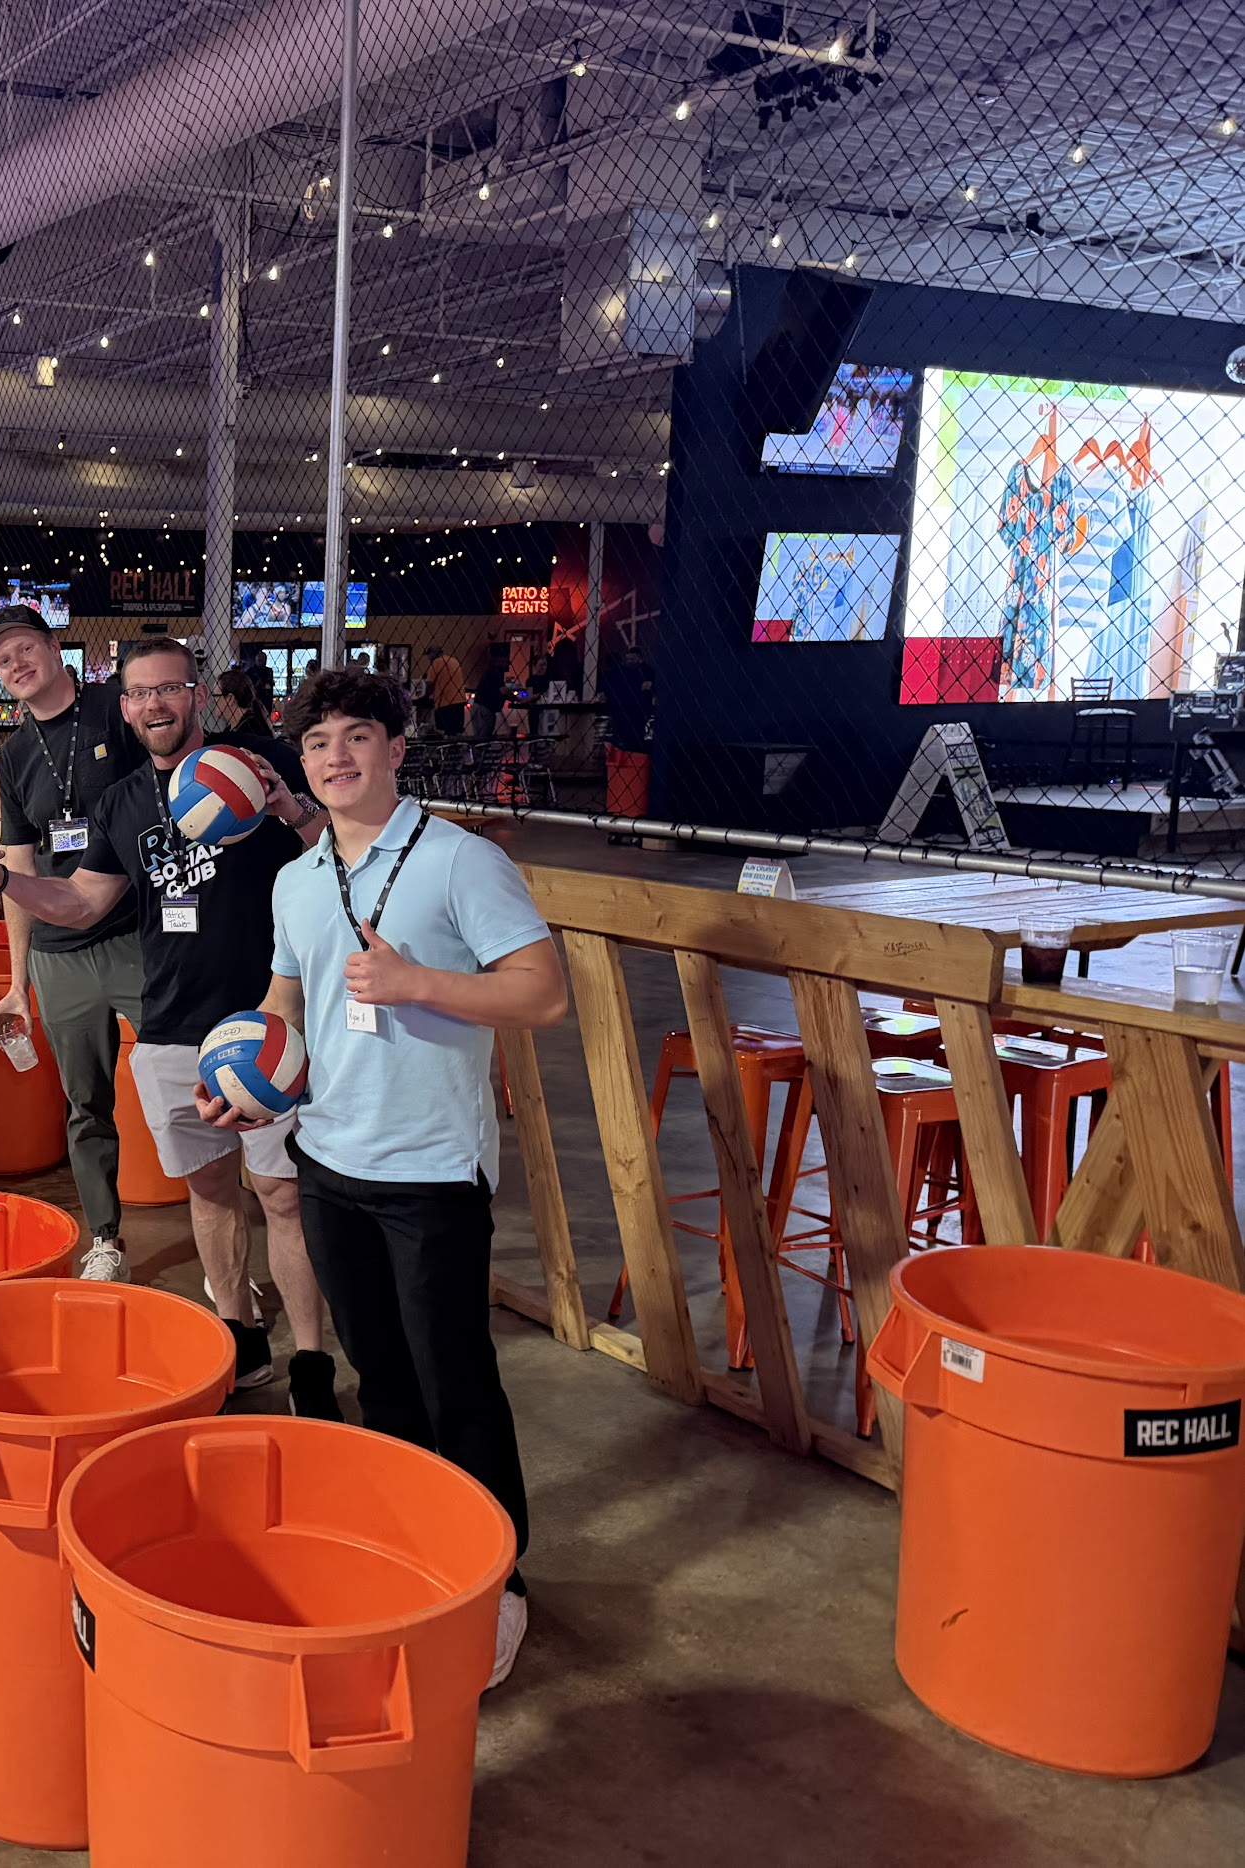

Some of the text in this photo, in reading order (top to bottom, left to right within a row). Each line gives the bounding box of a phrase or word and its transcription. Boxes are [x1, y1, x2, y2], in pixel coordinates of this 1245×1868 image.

[110, 571, 195, 600] REC HALL
[502, 586, 550, 600] PATIO &
[501, 600, 549, 613] EVENTS
[1136, 1413, 1232, 1447] REC HALL
